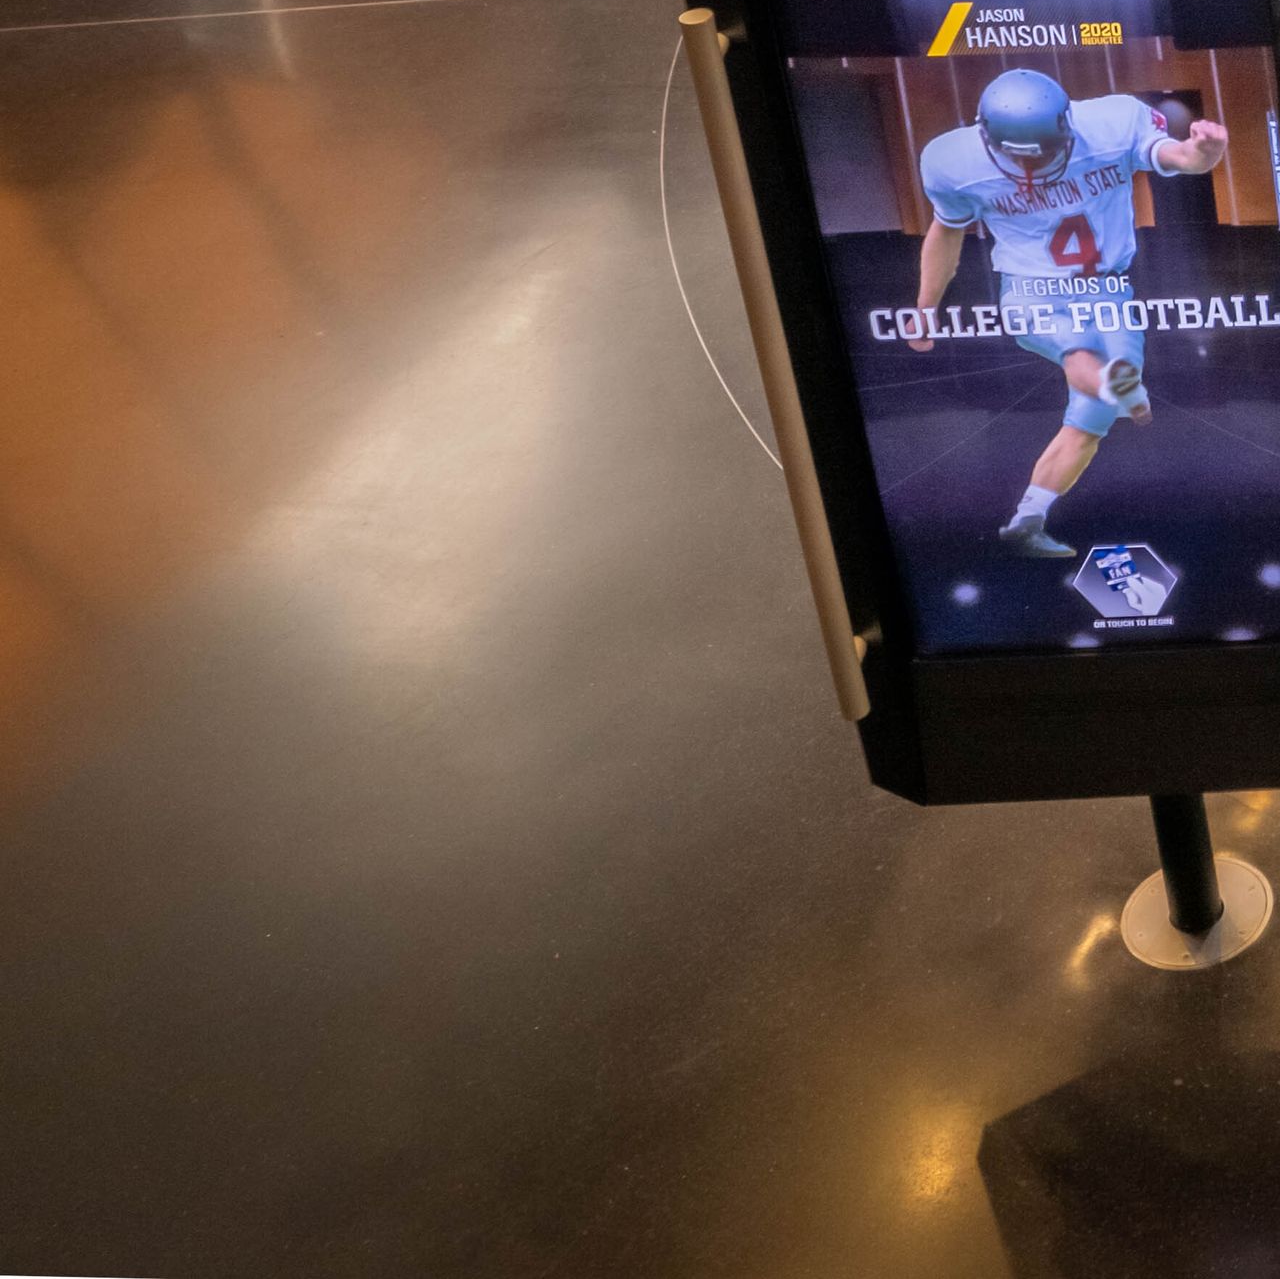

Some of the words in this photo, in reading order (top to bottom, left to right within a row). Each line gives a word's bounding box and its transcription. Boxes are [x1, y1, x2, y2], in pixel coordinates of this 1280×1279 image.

[976, 8, 1025, 23] JASON
[965, 24, 1067, 49] HANSON
[1080, 22, 1121, 37] 2020
[1081, 36, 1123, 46] INDUCTEE
[990, 177, 1083, 217] WASHINGTON
[1084, 164, 1127, 196] STATE
[1049, 213, 1103, 277] 4
[1012, 277, 1100, 297] LEGENDS
[1105, 275, 1131, 293] OF
[868, 303, 1058, 341] COLLEGE
[1108, 565, 1131, 579] FAN
[1093, 619, 1106, 628] OR
[1107, 619, 1134, 628] TOUCH
[1135, 619, 1147, 627] TO
